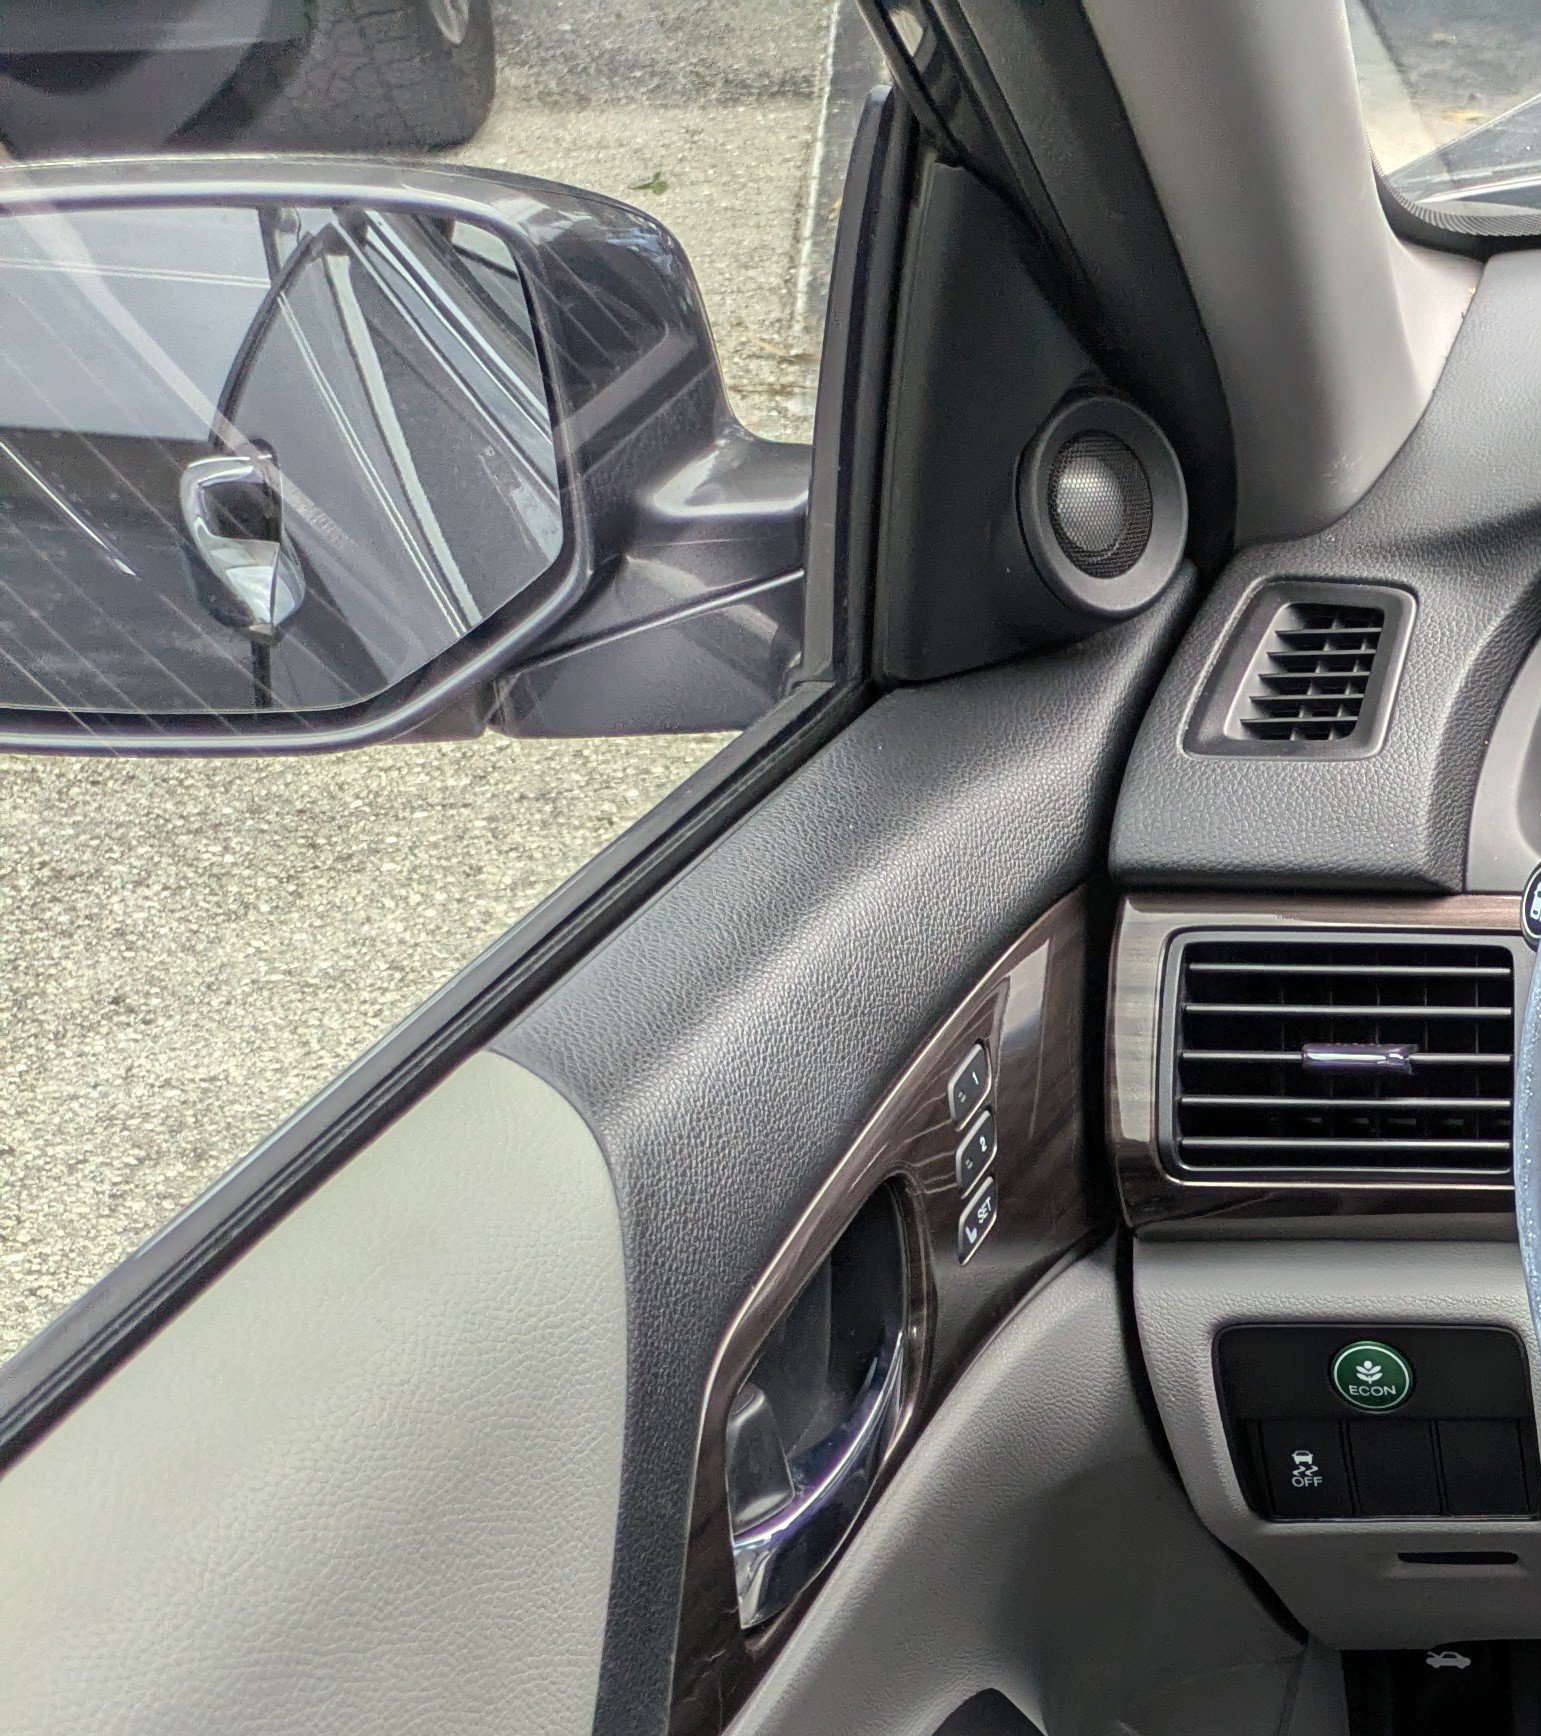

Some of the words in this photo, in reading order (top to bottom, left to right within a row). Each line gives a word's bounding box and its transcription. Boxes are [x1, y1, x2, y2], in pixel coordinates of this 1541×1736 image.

[979, 1136, 987, 1152] 2
[1348, 1384, 1397, 1398] ECON
[1291, 1475, 1323, 1488] OFF
